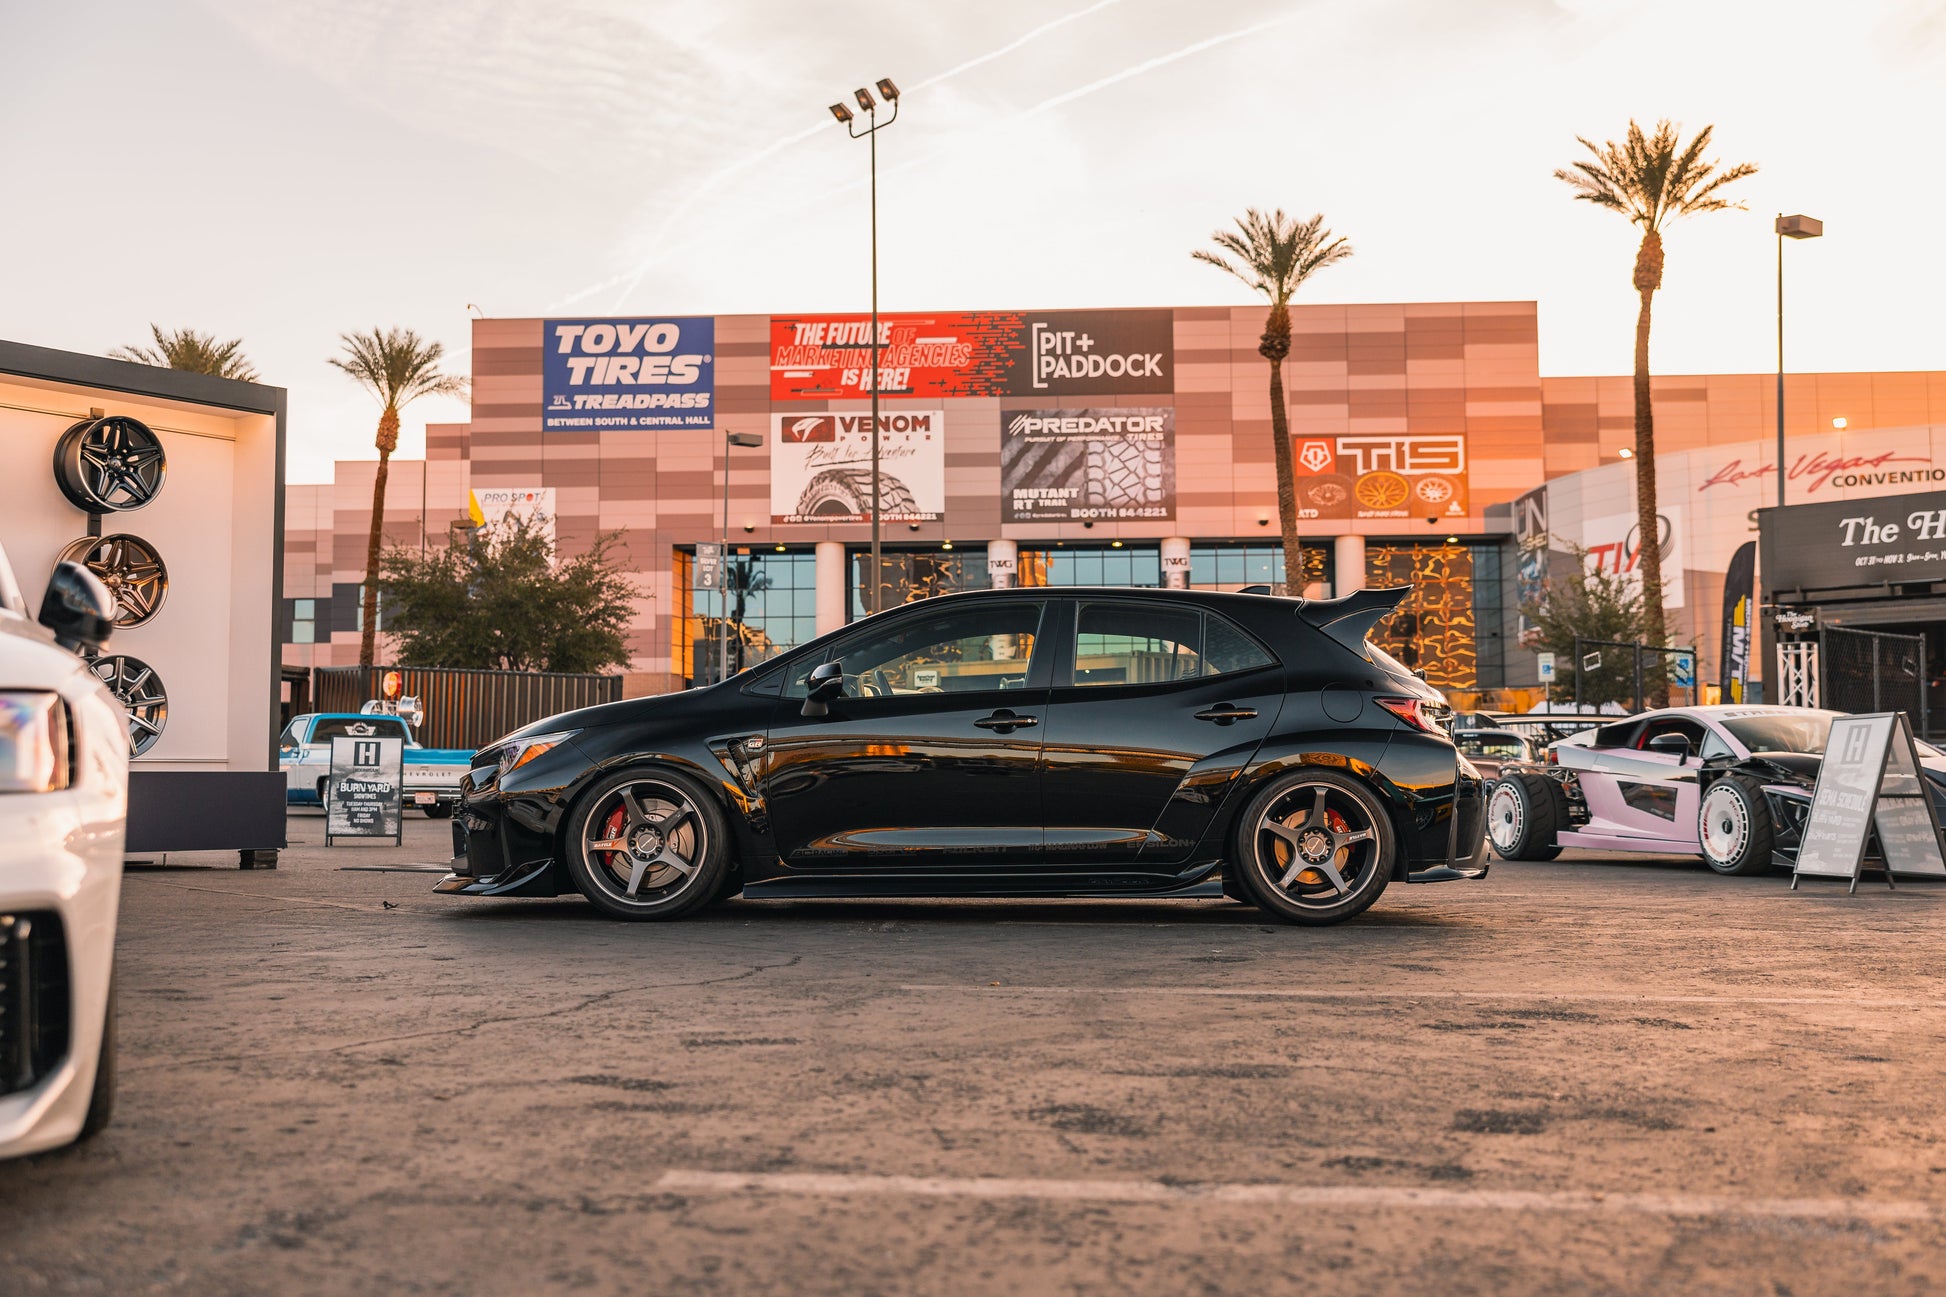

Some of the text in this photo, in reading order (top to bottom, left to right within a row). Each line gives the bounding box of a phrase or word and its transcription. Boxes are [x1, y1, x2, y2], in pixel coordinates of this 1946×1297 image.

[555, 323, 680, 354] TOYO
[794, 321, 917, 346] THE FUTURE OF
[882, 343, 973, 368] AGENCIES
[566, 354, 704, 386] TIRES
[1040, 353, 1163, 379] PADDOCK
[841, 369, 859, 386] IS
[573, 392, 710, 410] TREADPASS
[547, 415, 711, 426] BETWEEN SOUTH & CENTRAL HALL
[839, 415, 931, 433] VENOM
[1023, 415, 1164, 434] PREDATOR
[840, 434, 931, 442] POWER
[1127, 433, 1164, 441] TIRES
[1699, 451, 1932, 494] Las Vegas
[484, 493, 508, 503] PRO
[1013, 488, 1080, 499] MUTANT
[1013, 499, 1067, 510] RT TRAIL
[1071, 508, 1117, 518] BOOTH
[1839, 516, 1900, 547] The
[1883, 554, 1898, 565] NOV
[703, 573, 712, 586] 3
[340, 782, 390, 793] BURN YARD
